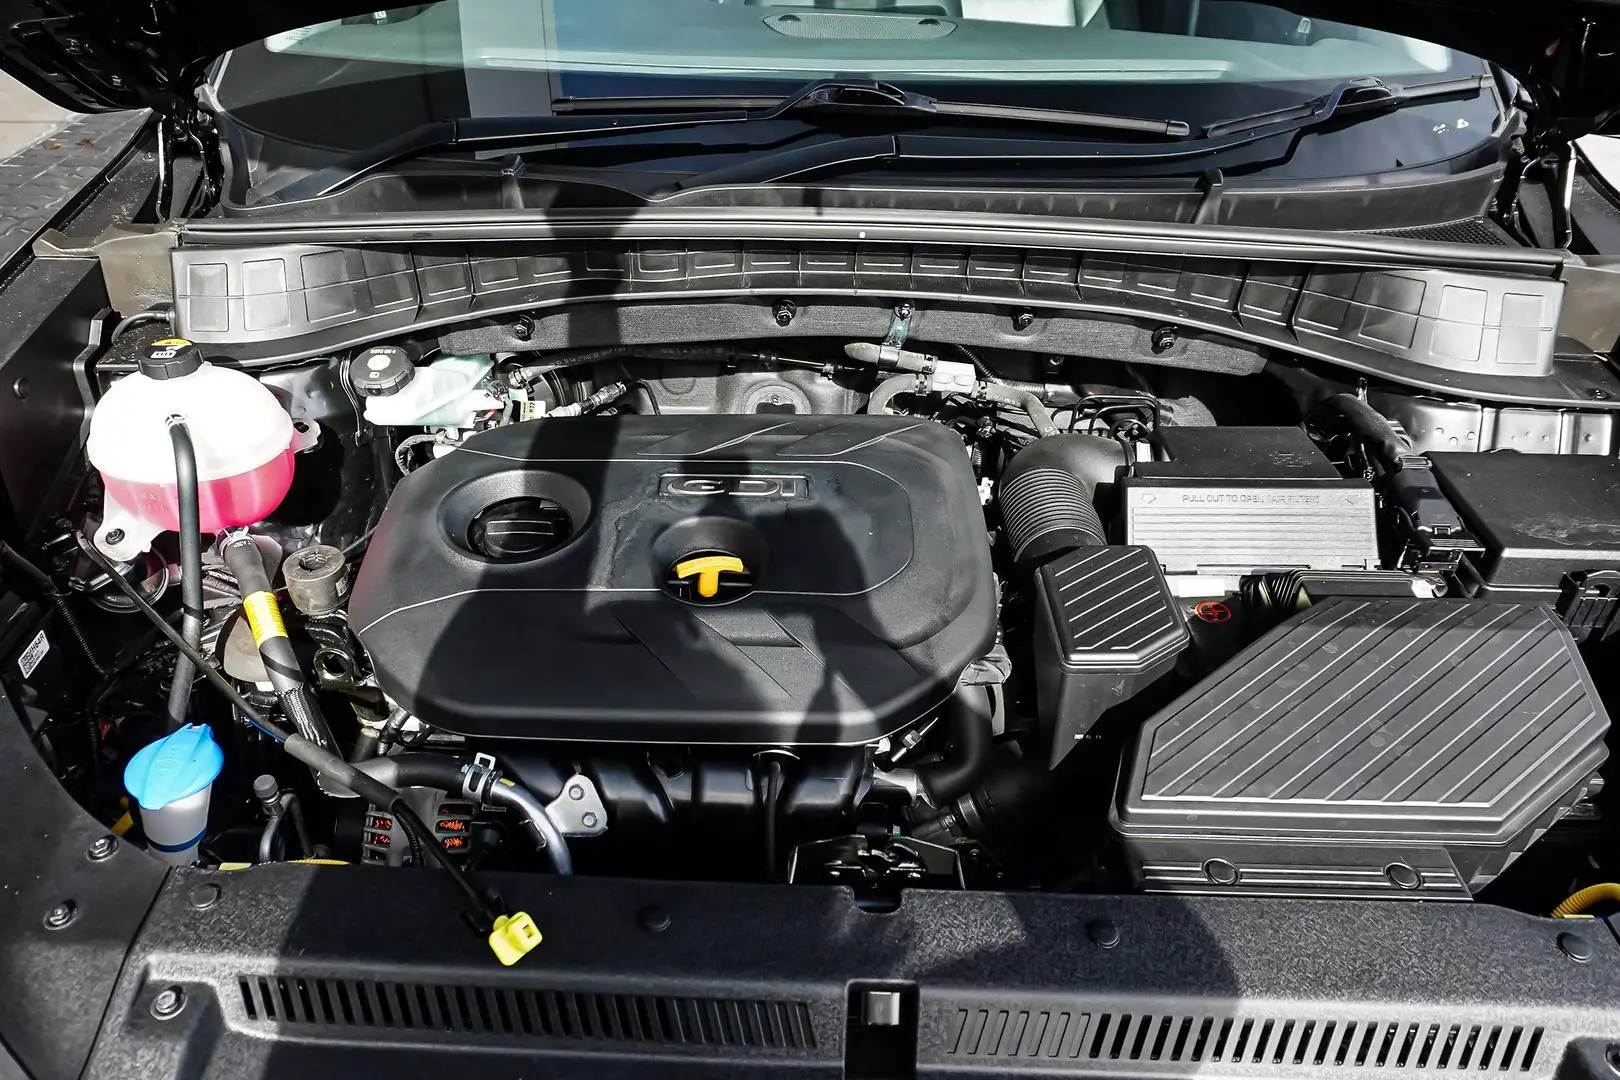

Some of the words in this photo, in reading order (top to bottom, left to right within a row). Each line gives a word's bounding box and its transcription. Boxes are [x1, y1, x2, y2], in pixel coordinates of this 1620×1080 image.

[667, 479, 797, 497] GDI
[1182, 494, 1205, 503] PULL
[1206, 494, 1224, 503] OUT
[1226, 494, 1237, 503] TO
